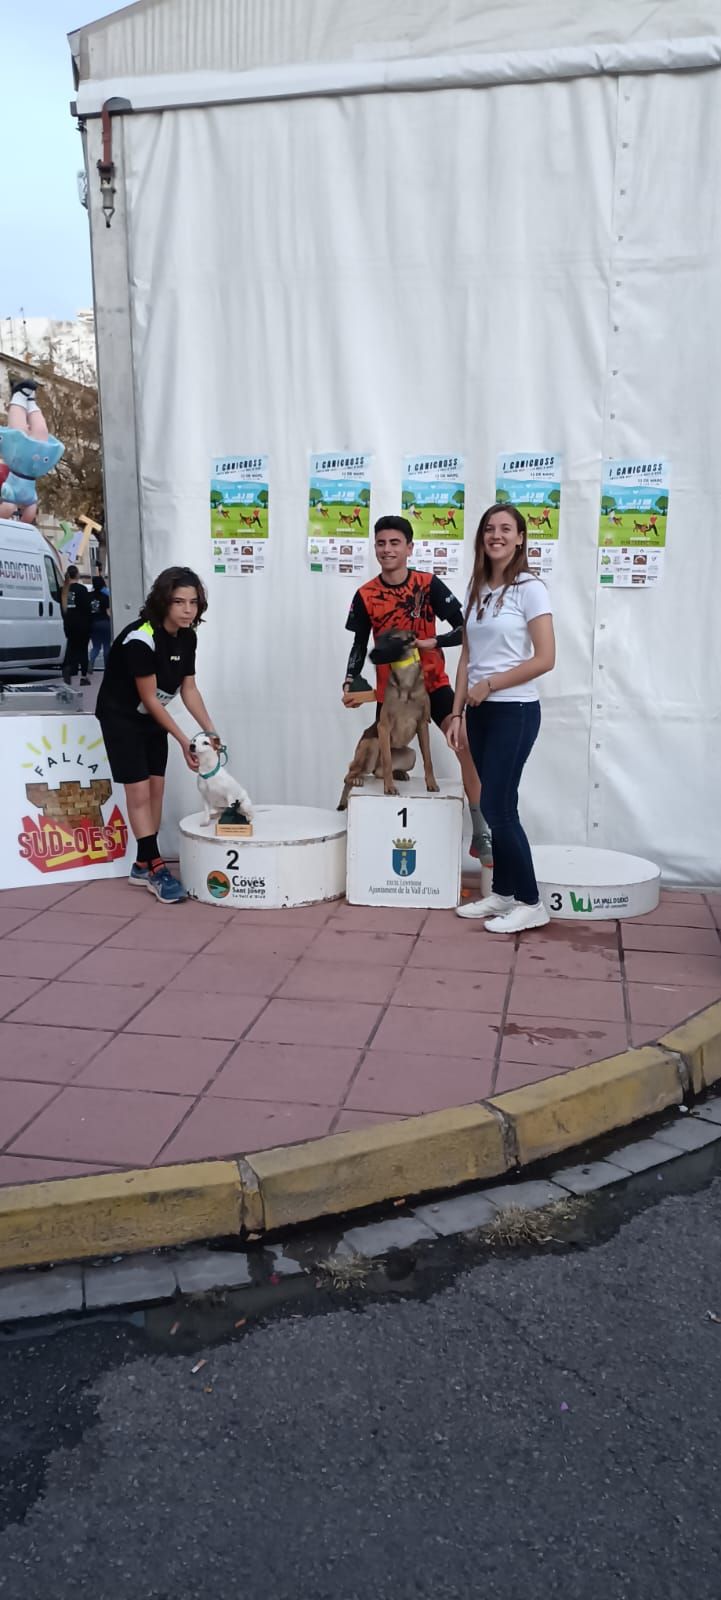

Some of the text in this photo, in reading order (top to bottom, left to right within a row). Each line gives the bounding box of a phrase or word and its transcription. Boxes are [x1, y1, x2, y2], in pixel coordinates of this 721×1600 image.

[222, 459, 262, 471] CANICROSS
[322, 457, 364, 468] CANICROSS
[415, 458, 458, 471] CANICROSS
[510, 457, 554, 469] CANICROSS
[616, 464, 662, 476] CANICROSS
[34, 752, 99, 777] FALLA
[397, 807, 408, 828] 1
[17, 826, 128, 859] SUD-OEST
[226, 849, 240, 870] 2
[232, 875, 266, 888] Coves
[550, 893, 562, 911] 3
